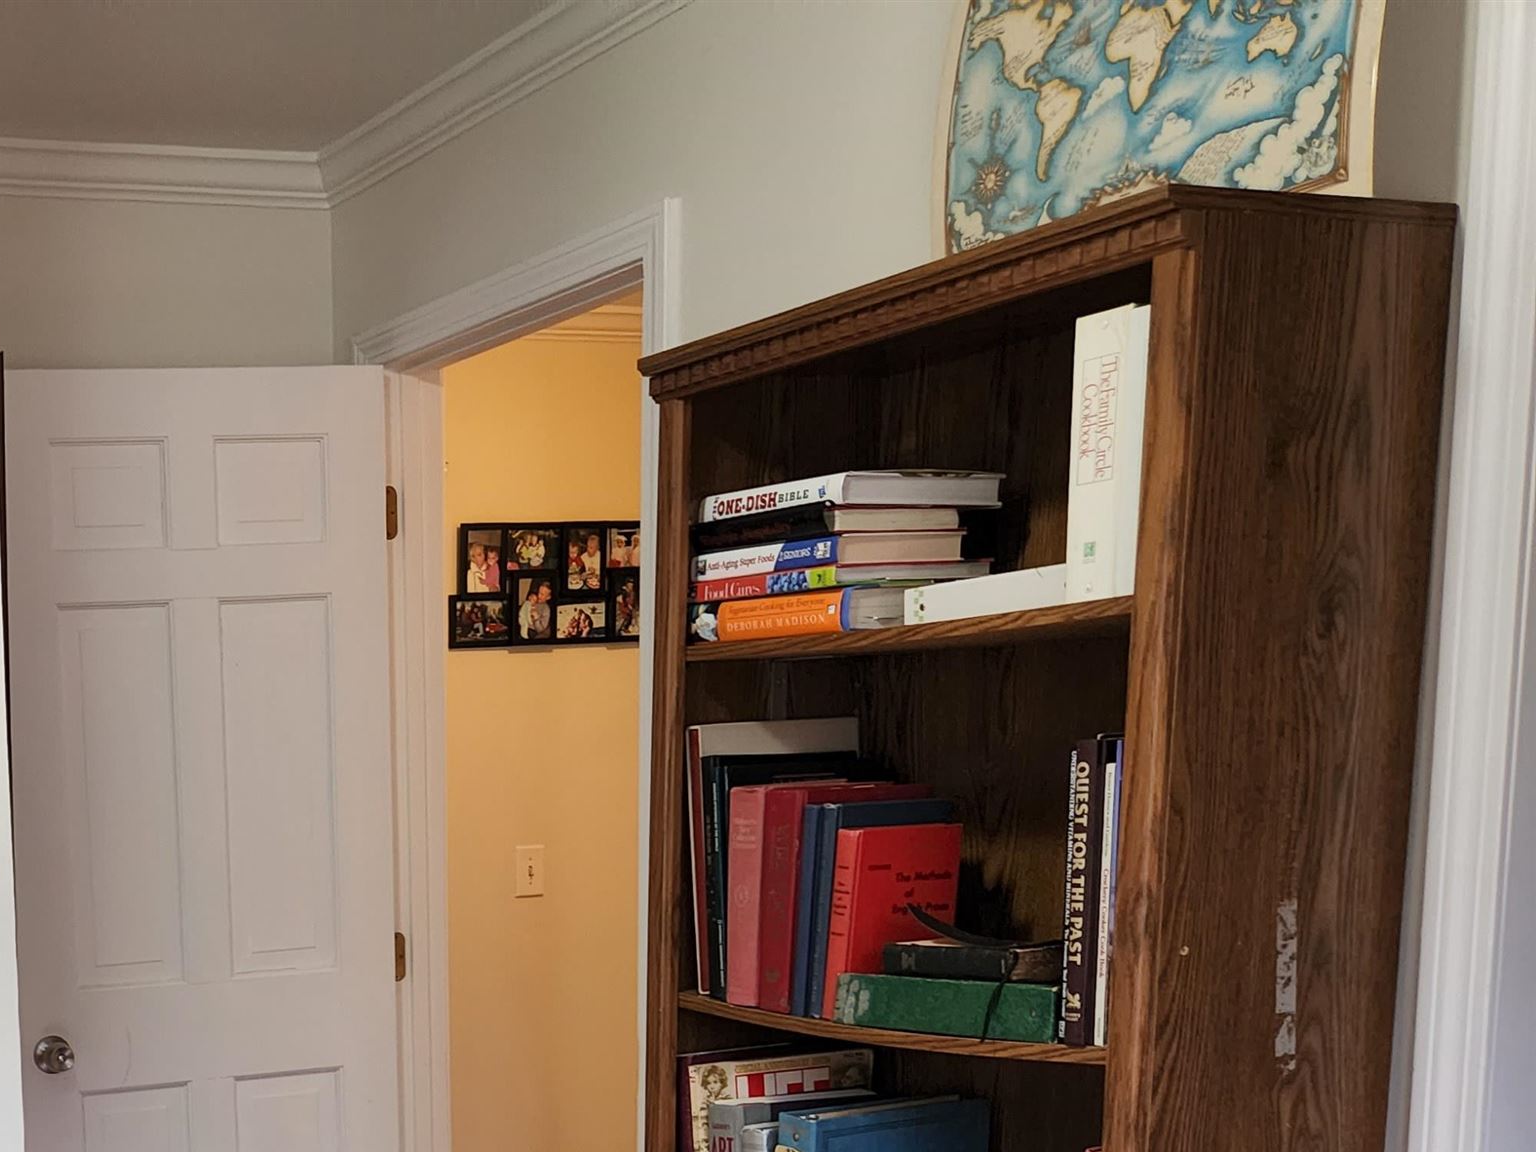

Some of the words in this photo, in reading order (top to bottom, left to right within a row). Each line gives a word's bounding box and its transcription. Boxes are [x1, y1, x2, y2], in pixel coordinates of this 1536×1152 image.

[1079, 383, 1099, 460] Cookbook
[717, 492, 778, 516] ONE-DISH
[778, 489, 809, 503] BIBLE
[707, 558, 739, 571] Anti-Aging
[758, 553, 775, 563] Foods
[775, 613, 825, 628] MADISON
[1075, 761, 1090, 827] QUEST
[1072, 832, 1087, 871] FOR
[1070, 875, 1085, 912] THE
[1068, 917, 1083, 966] PAST
